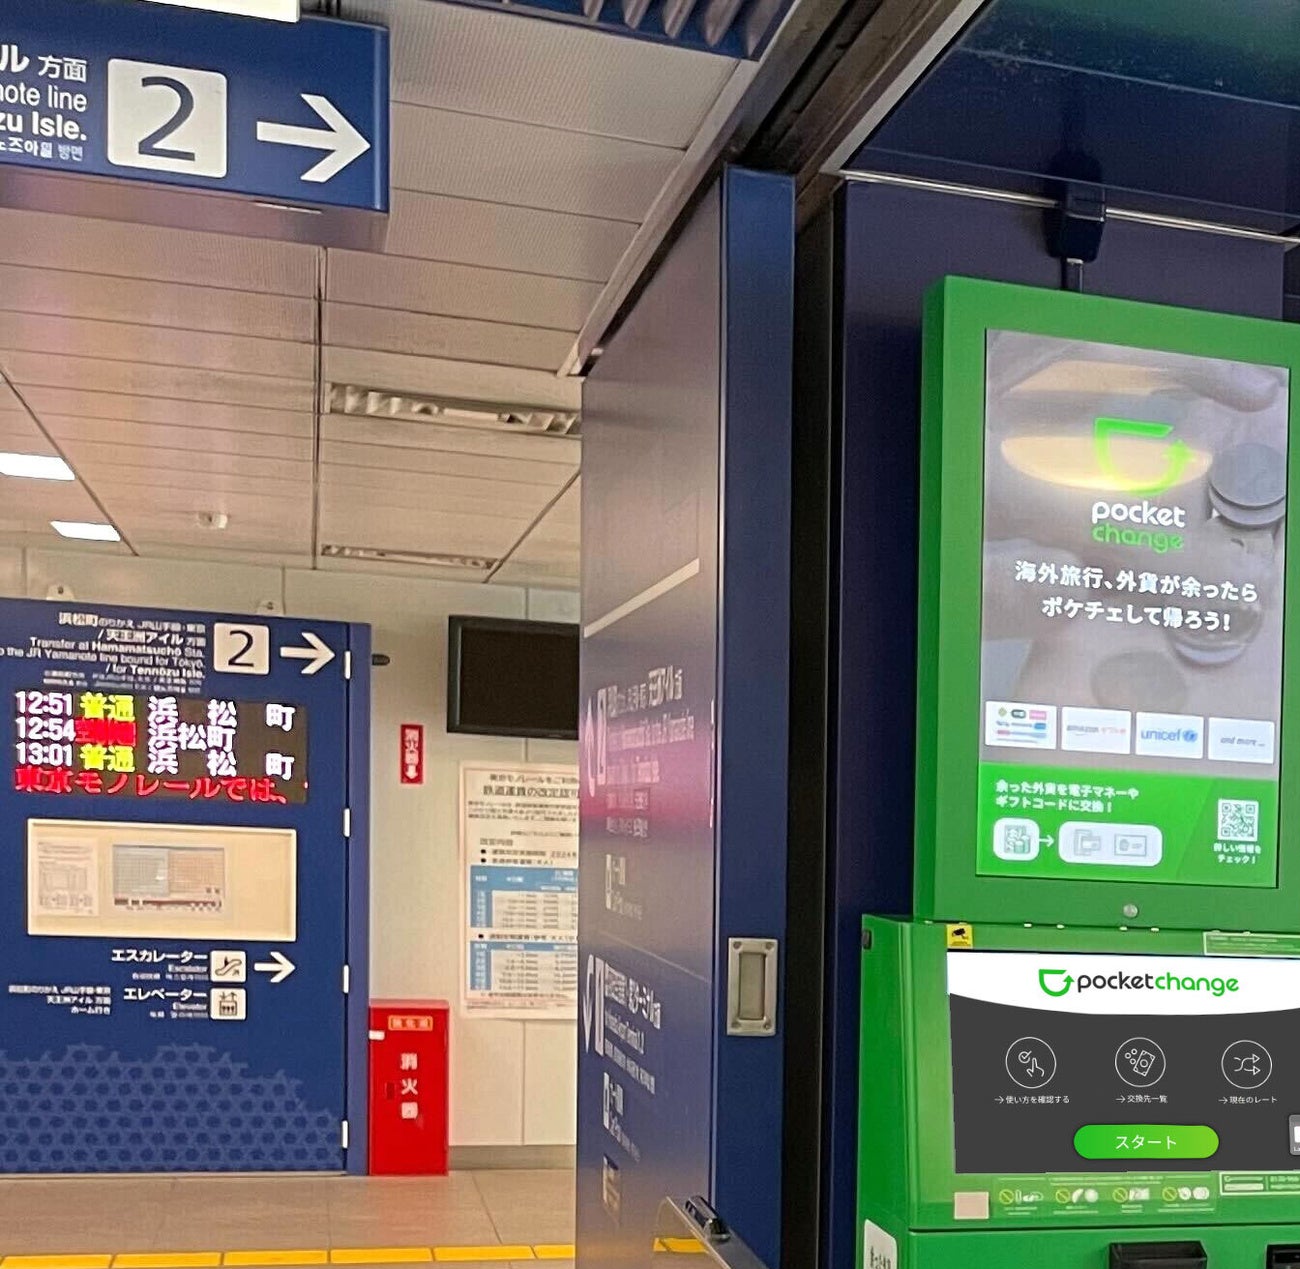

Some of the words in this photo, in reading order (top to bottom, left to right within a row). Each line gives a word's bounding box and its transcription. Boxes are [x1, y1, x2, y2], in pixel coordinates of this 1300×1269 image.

[38, 55, 87, 83] 方面
[0, 82, 41, 106] ote
[48, 84, 87, 112] line
[32, 111, 87, 141] Isle.
[139, 76, 195, 161] 2
[1092, 500, 1186, 528] pocket
[1092, 523, 1184, 554] change
[1014, 560, 1258, 602] 海外旅行、外貨が余ったら
[226, 633, 255, 667] 2
[15, 691, 73, 715] 12:51
[80, 692, 135, 722] 普通
[15, 716, 76, 741] 12:54
[147, 721, 236, 751] 浜松町
[1141, 728, 1181, 742] unicef
[15, 742, 73, 766] 13:01
[80, 743, 135, 772] 普通
[111, 948, 208, 964] エスカレーター
[124, 987, 208, 1001] エレベーター
[1077, 970, 1239, 997] pocketchange
[1005, 1094, 1070, 1105] 使い方を確認する
[1127, 1094, 1168, 1104] 交換先一覧
[1229, 1094, 1278, 1105] 現在のレート
[1115, 1135, 1177, 1151] スタート
